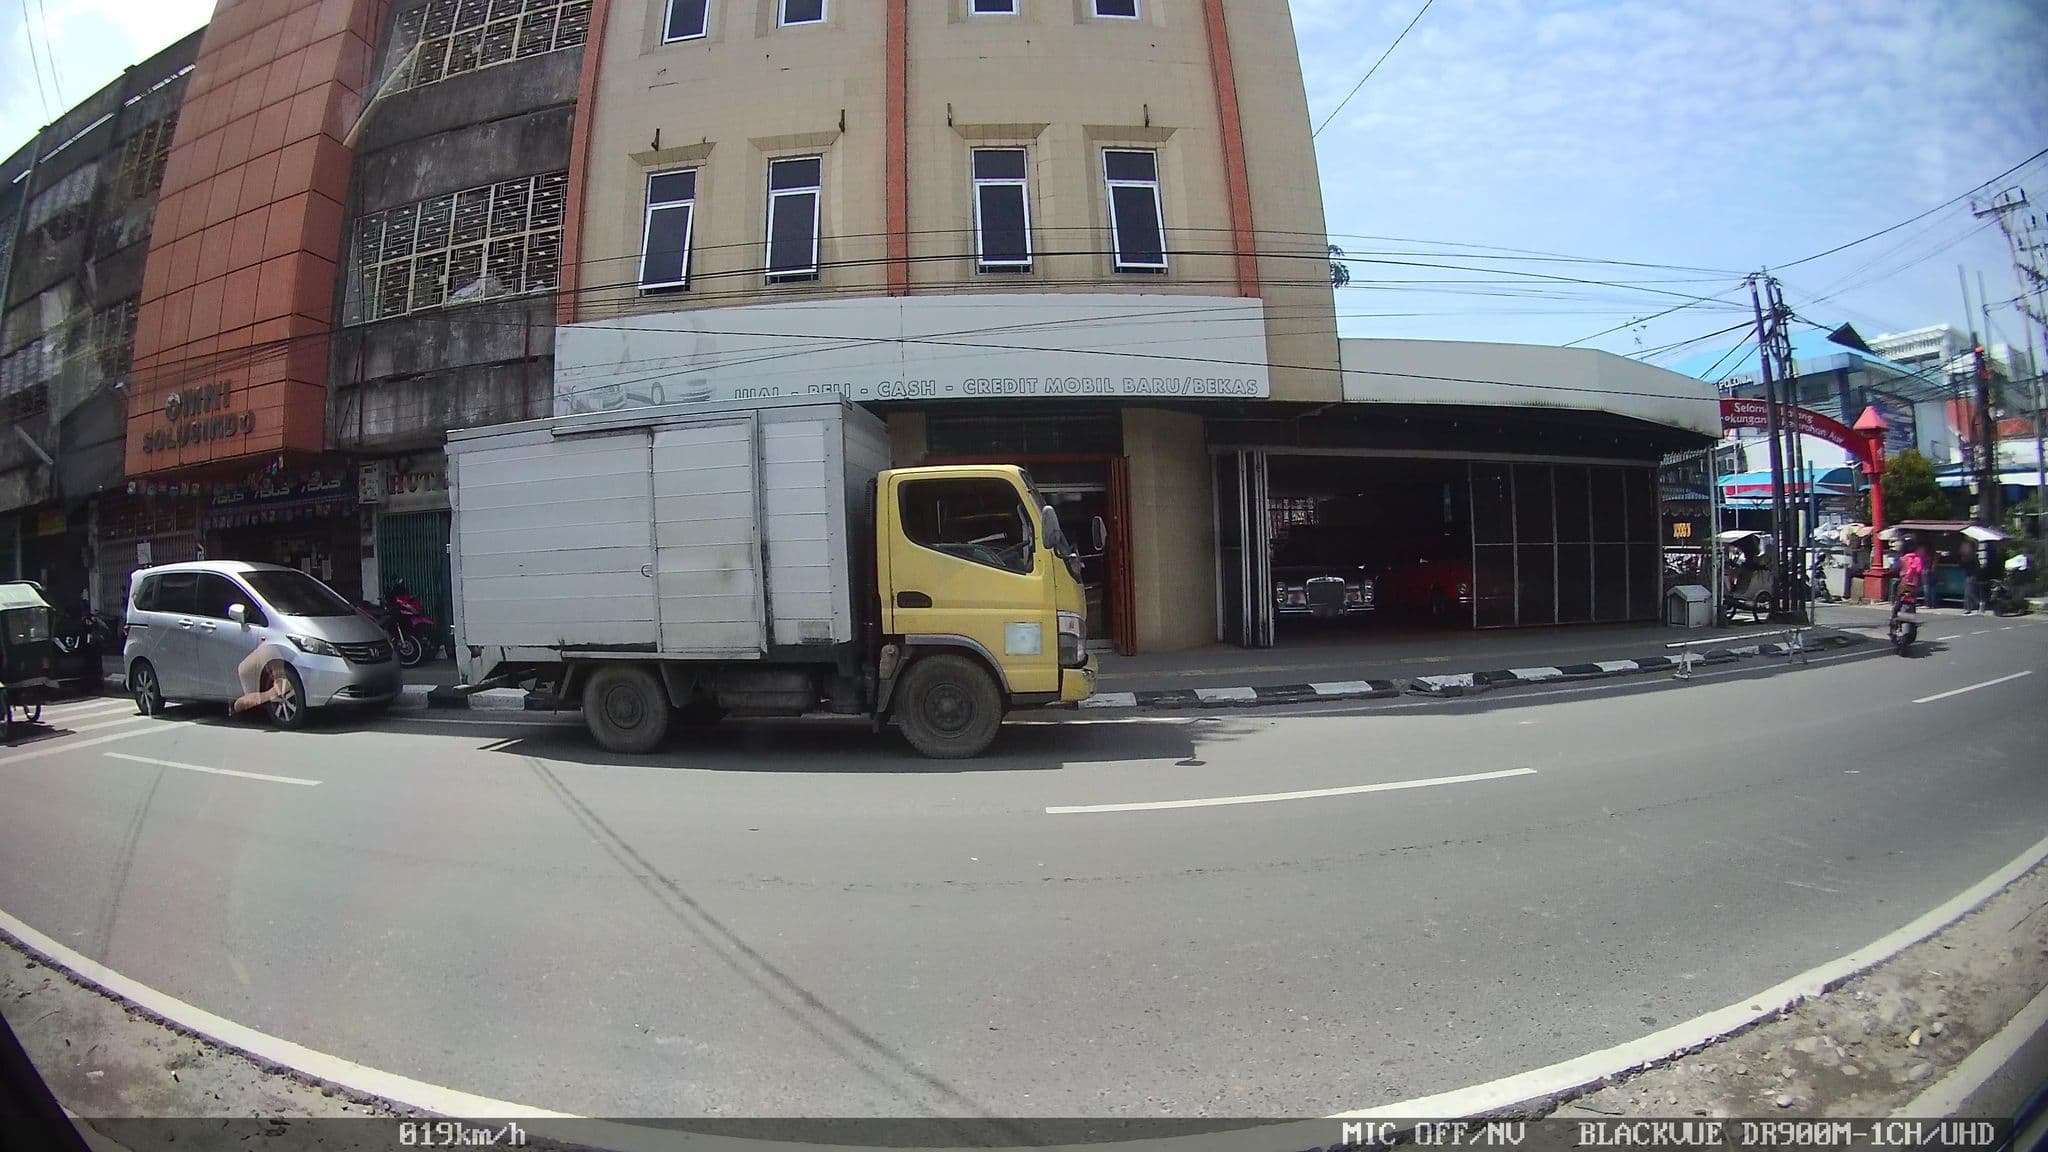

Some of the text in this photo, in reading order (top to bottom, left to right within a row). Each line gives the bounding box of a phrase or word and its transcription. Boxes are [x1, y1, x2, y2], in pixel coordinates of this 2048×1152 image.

[877, 380, 936, 397] CASH
[962, 378, 1038, 395] CREDIT
[1044, 378, 1114, 394] MOBIL
[1122, 377, 1259, 395] BARU/BEKAS
